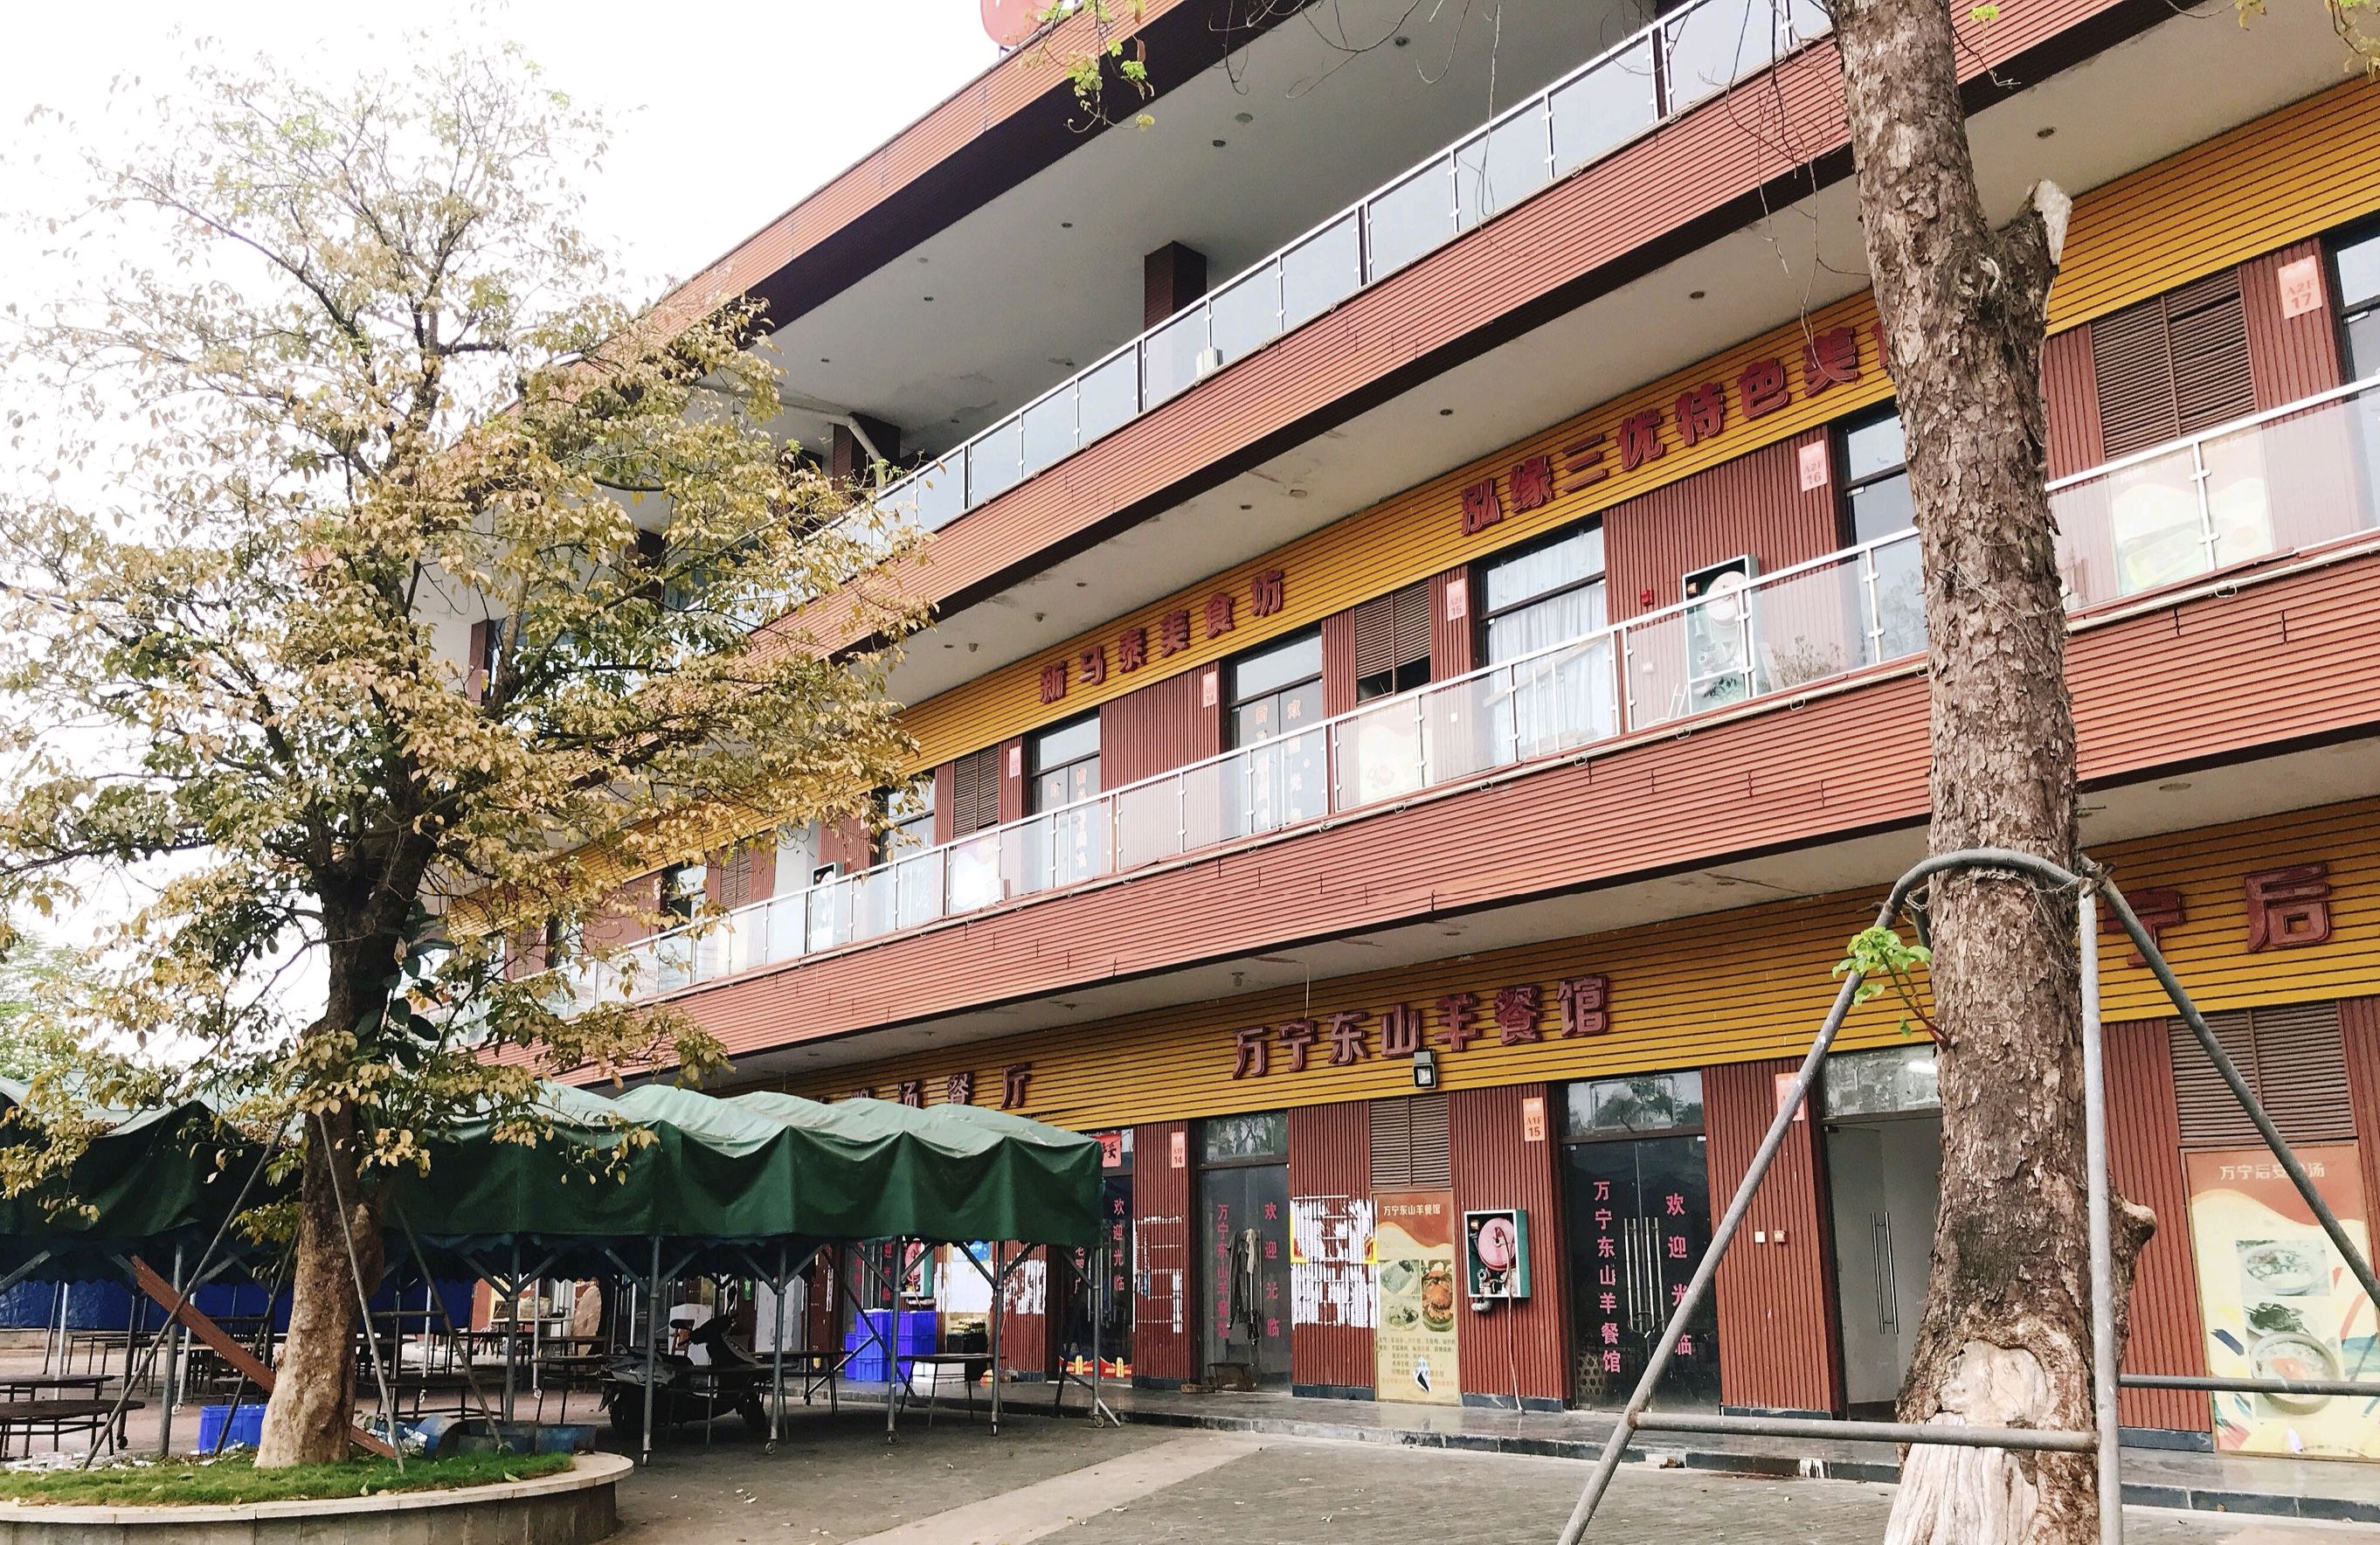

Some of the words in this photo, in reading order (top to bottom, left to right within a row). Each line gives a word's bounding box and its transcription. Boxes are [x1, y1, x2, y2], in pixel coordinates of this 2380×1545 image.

[2292, 292, 2312, 309] 17
[1461, 322, 1891, 537] 泓缘三优特色美
[1806, 472, 1822, 485] 16
[1039, 569, 1285, 703] 新马泰美食坊
[1232, 973, 1611, 1079] 万宁东山羊餐馆
[1173, 1156, 1183, 1165] 14
[1529, 1126, 1540, 1138] 15
[2219, 1162, 2326, 1181] 万宁后安汤
[1112, 1199, 1124, 1292] 欢迎光临
[1383, 1204, 1441, 1216] 万宁东山羊餐馆
[1264, 1202, 1280, 1338] 欢迎光临
[1594, 1181, 1621, 1373] 万宁东山羊餐馆
[1665, 1193, 1694, 1356] 欢迎光临
